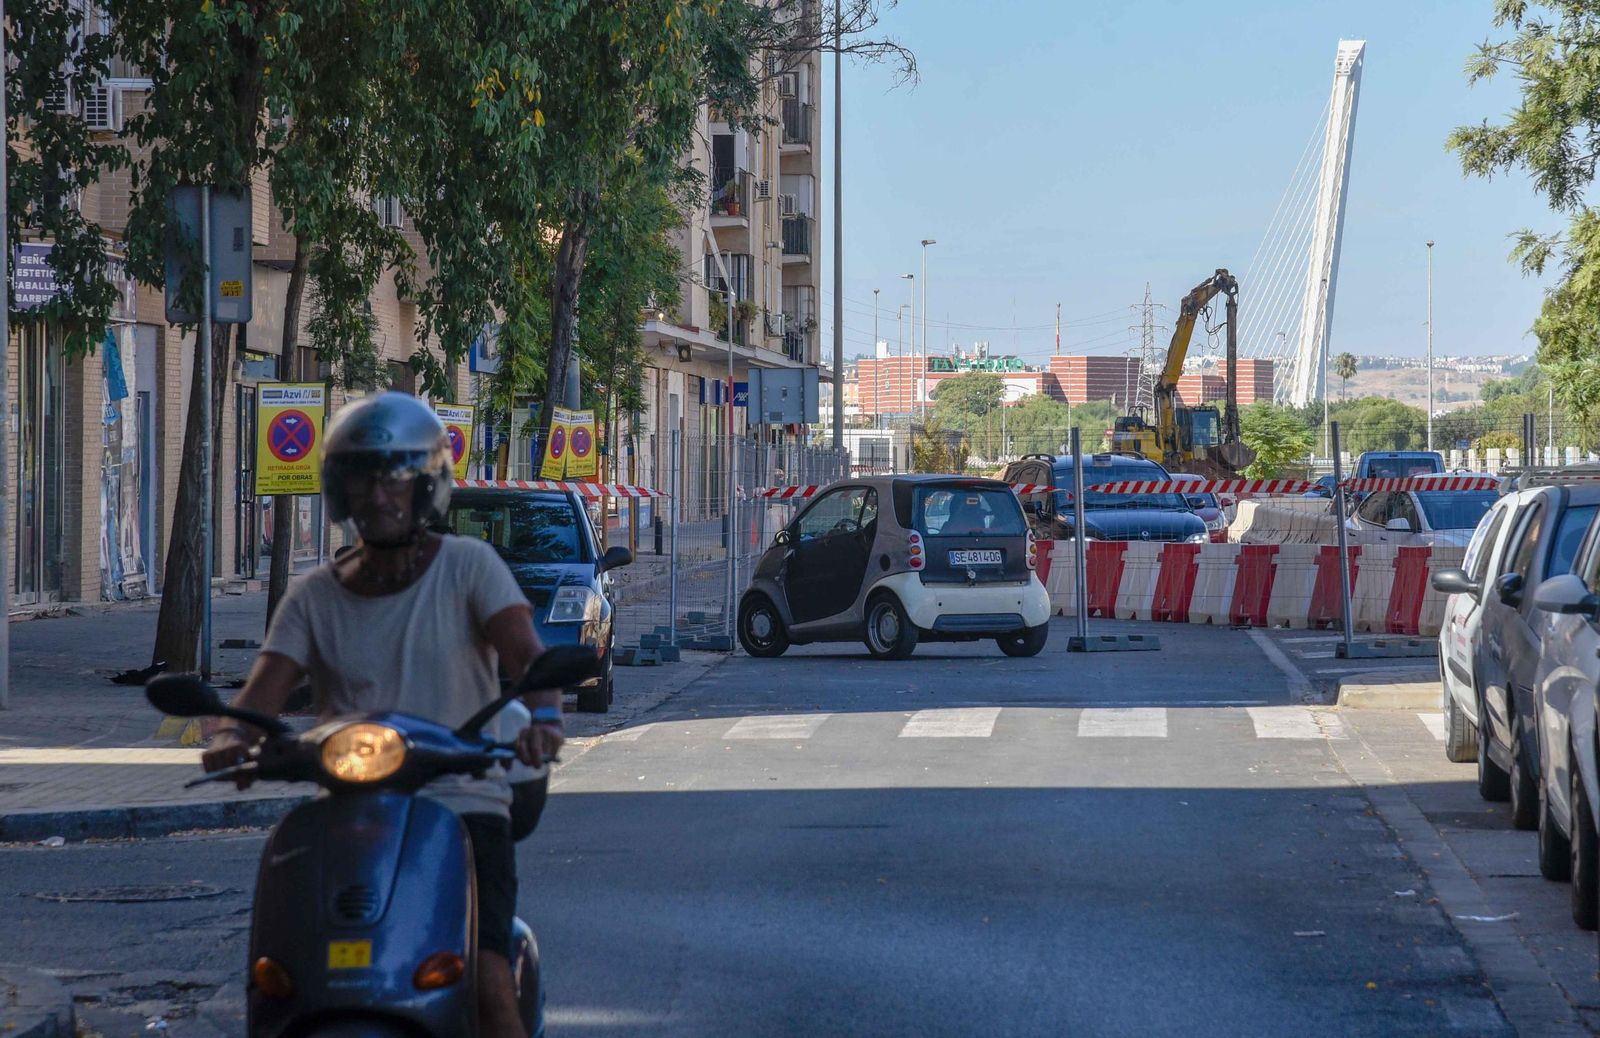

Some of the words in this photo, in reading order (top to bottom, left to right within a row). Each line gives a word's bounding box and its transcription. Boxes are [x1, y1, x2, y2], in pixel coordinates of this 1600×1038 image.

[20, 254, 48, 265] SEÑO
[16, 268, 57, 279] ESTETIC
[932, 357, 1024, 371] TANATORIO
[283, 389, 301, 399] Azvi
